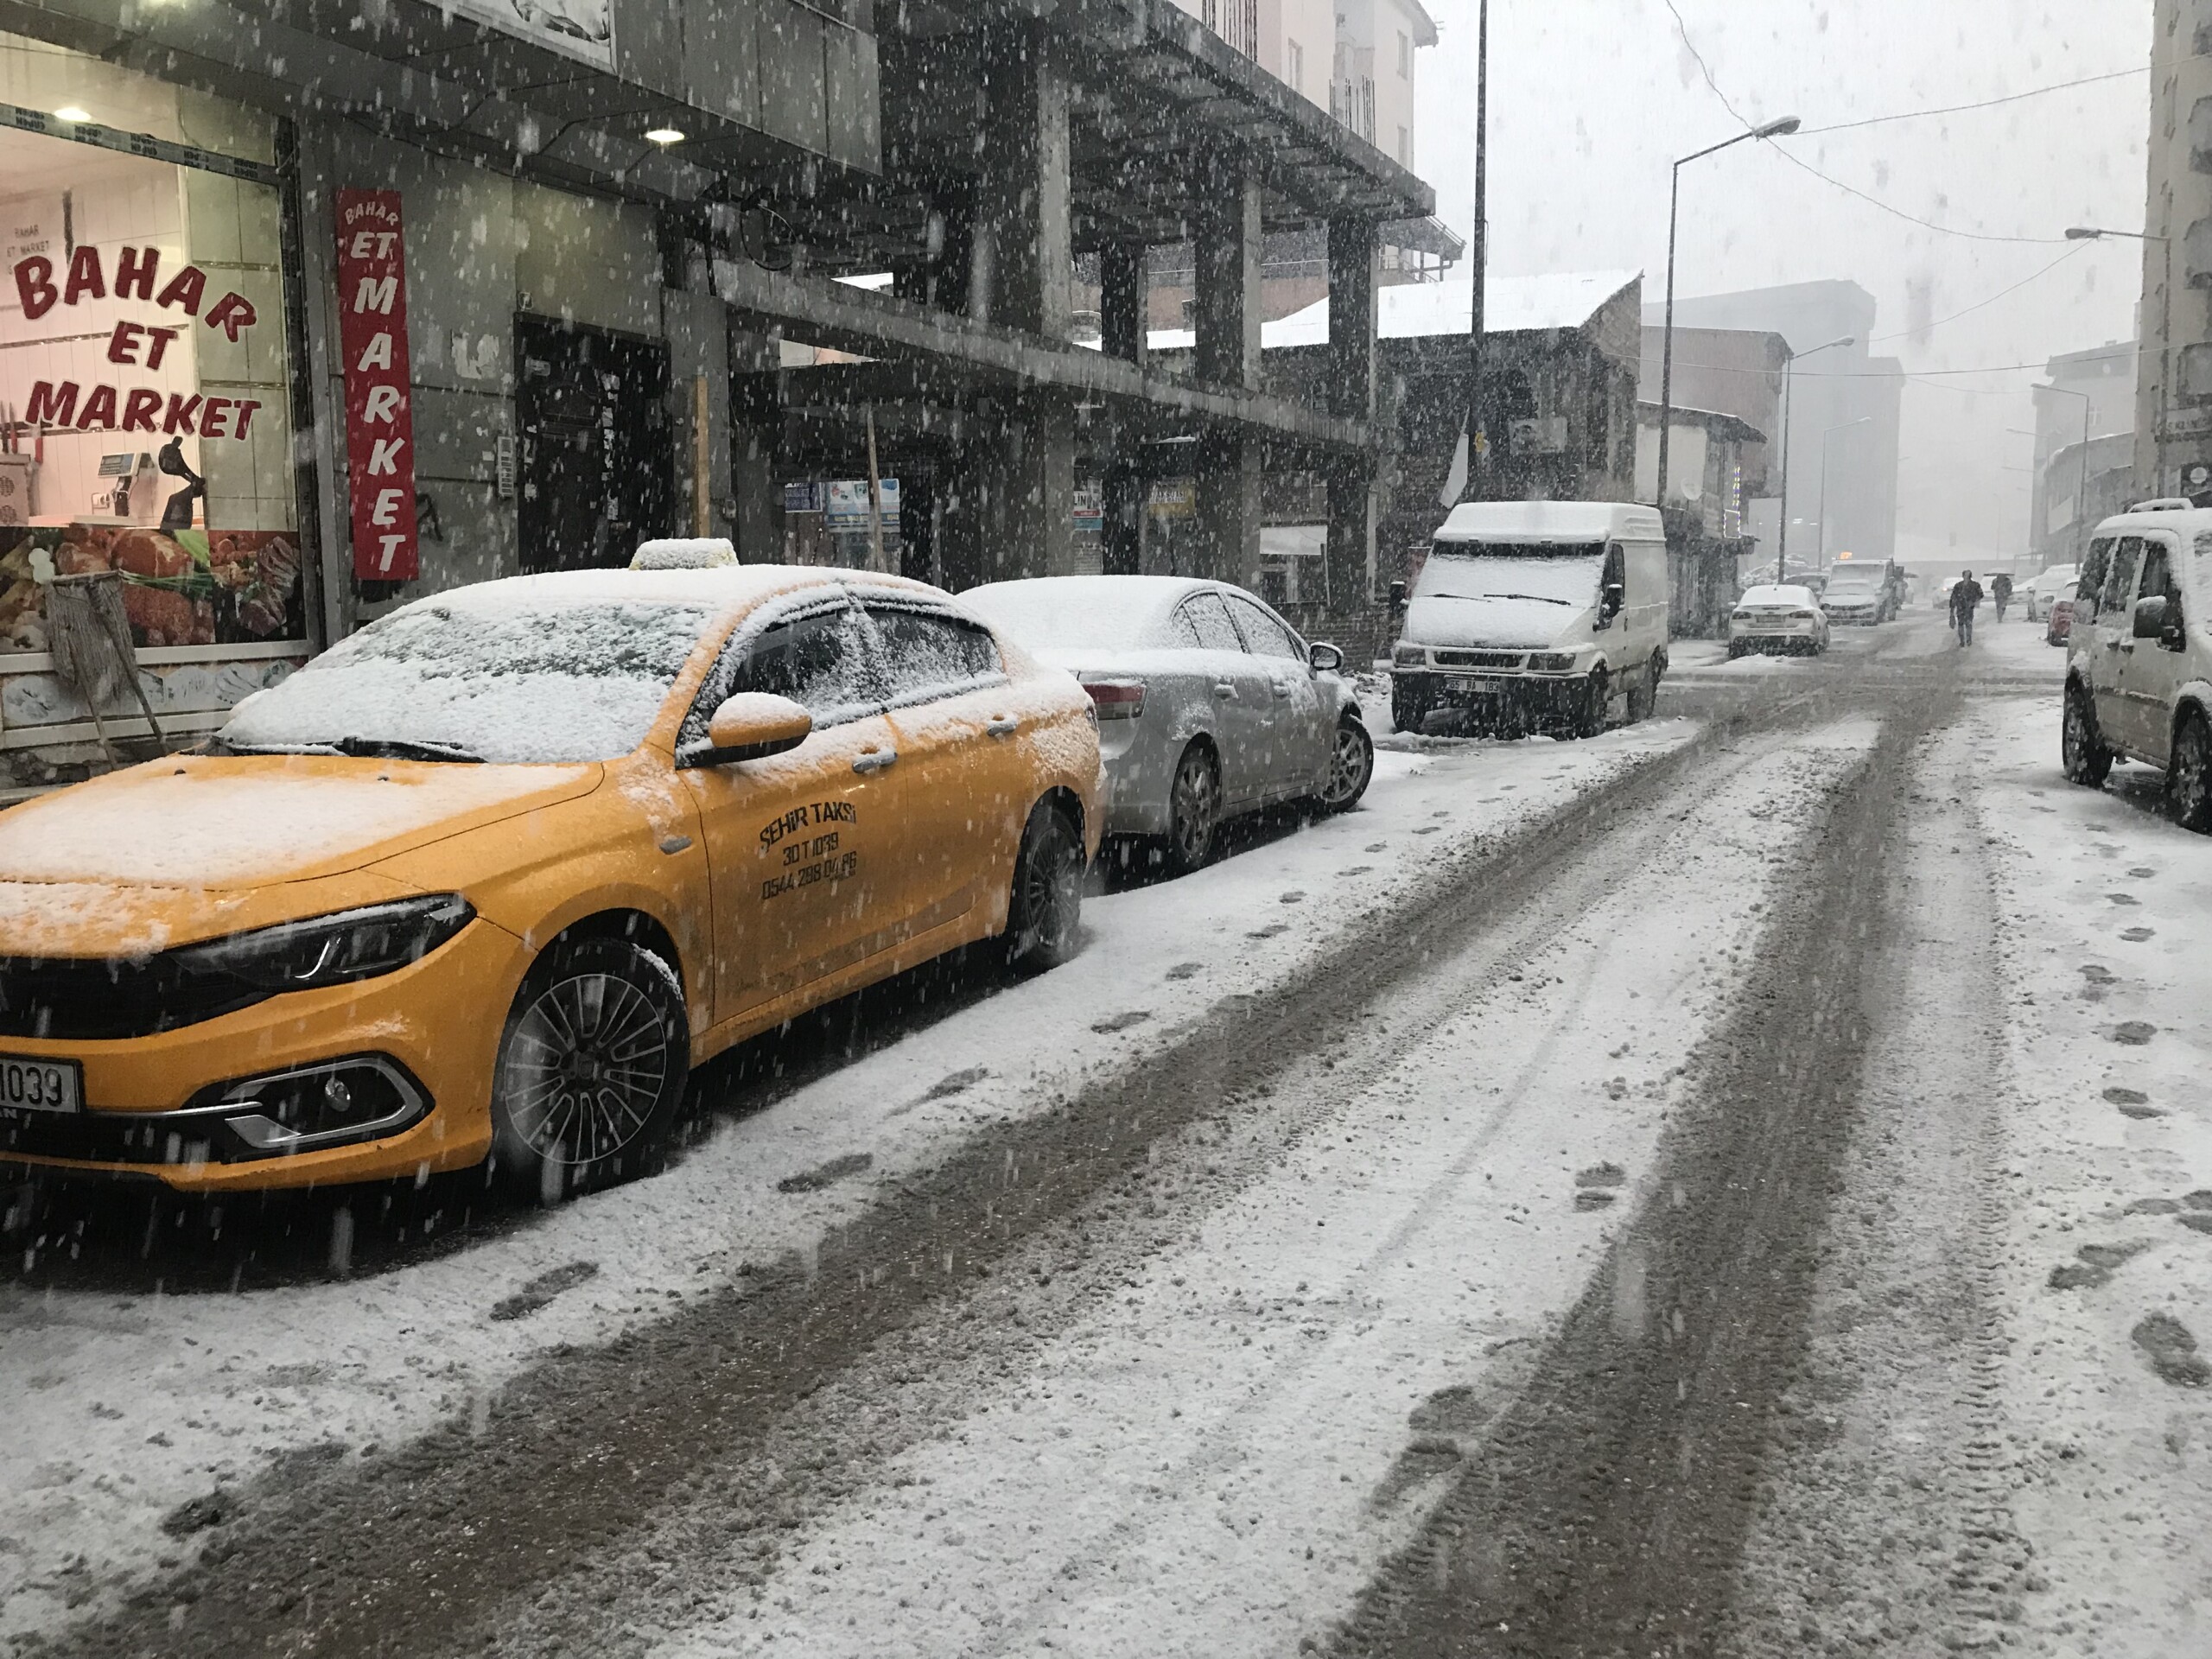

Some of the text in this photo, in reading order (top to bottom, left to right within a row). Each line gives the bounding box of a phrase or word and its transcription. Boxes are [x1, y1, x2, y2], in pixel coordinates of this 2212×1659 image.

[345, 200, 399, 226] BAHAR
[350, 231, 398, 258] ET
[14, 245, 257, 342] BAHAR
[107, 320, 178, 372] ET
[24, 380, 262, 442] MARKET
[353, 276, 406, 572] MARKET
[783, 844, 800, 867] 30
[812, 831, 839, 857] 1039
